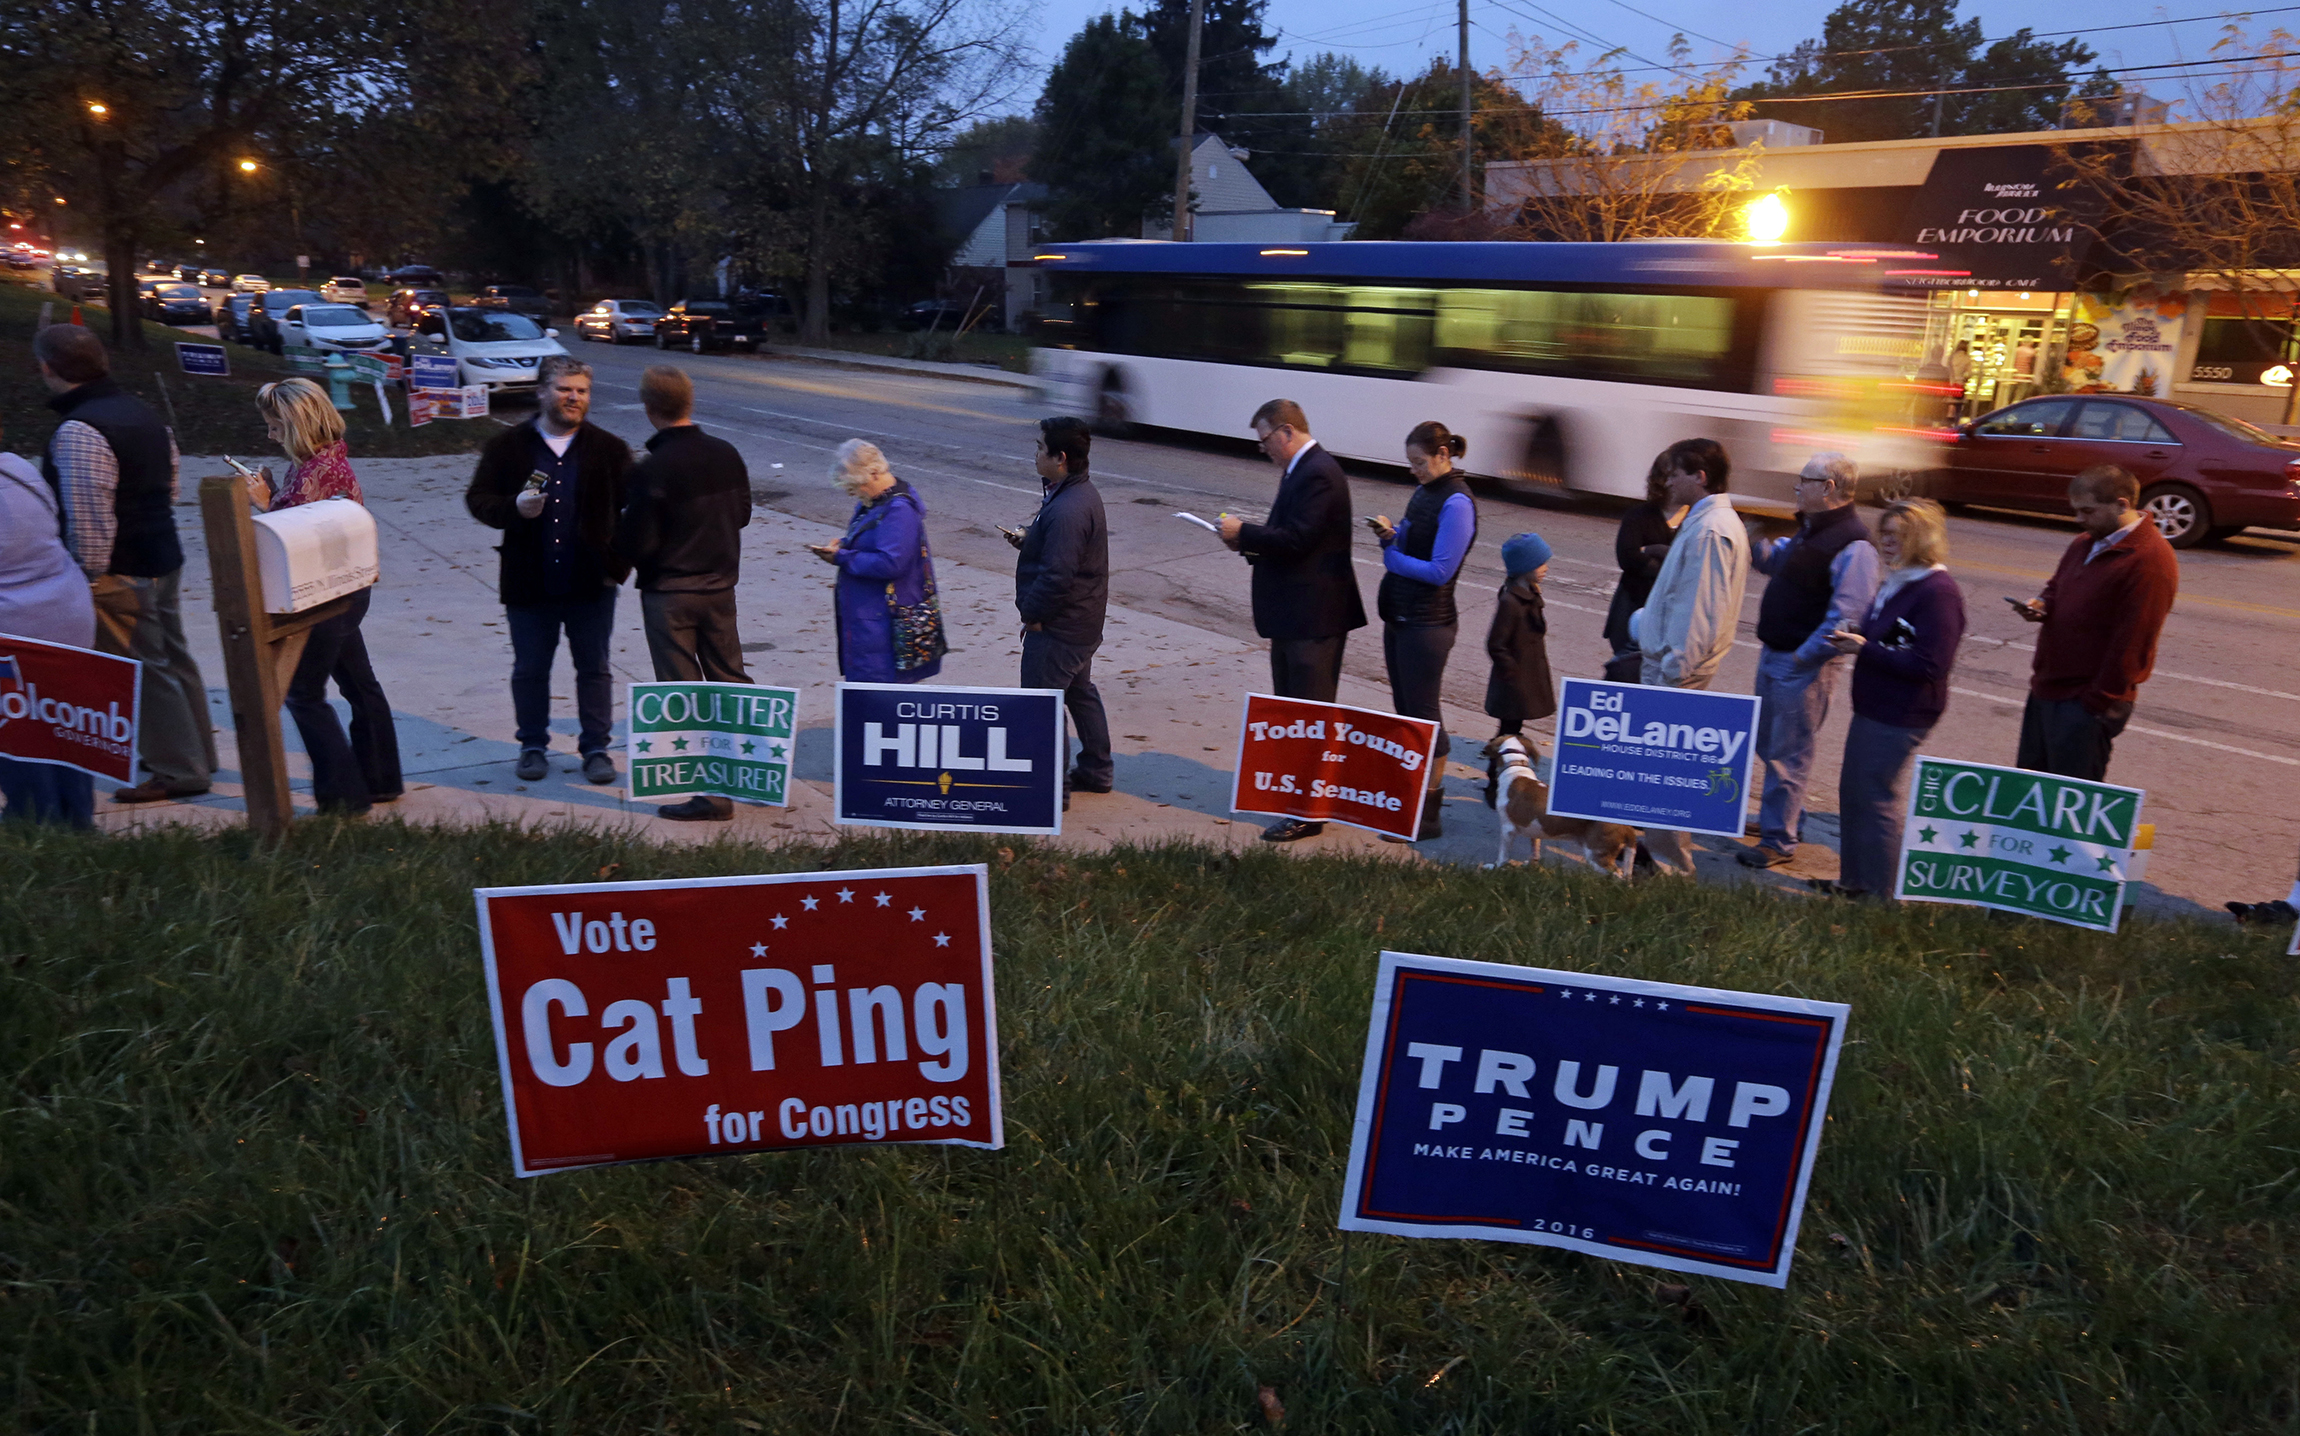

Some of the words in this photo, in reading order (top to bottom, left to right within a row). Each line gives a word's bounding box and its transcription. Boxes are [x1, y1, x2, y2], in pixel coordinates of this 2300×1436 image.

[1916, 226, 2074, 244] EMPORIUM
[1957, 207, 2047, 225] FOOD
[2191, 366, 2233, 379] 5550
[0, 682, 132, 743] olcomb
[635, 691, 790, 730] COULTER
[896, 701, 1000, 722] CURTIS
[1588, 690, 1624, 712] Ed
[53, 726, 132, 758] GOVERNOR
[700, 736, 732, 750] FOR
[863, 721, 1033, 773] HILL
[1249, 719, 1325, 742] Todd
[1333, 721, 1424, 771] Young
[1563, 706, 1748, 765] DeLaney
[1601, 743, 1643, 756] HOUSE
[1644, 748, 1699, 762] DISTRICT
[1321, 750, 1347, 763] for
[1560, 763, 1614, 779] LEADING
[1616, 769, 1635, 782] ON
[1637, 772, 1662, 785] THE
[634, 761, 782, 794] TREASURER
[1254, 771, 1303, 795] U.S.
[1310, 779, 1402, 812] Senate
[1920, 767, 1944, 812] CHIC
[883, 797, 949, 811] ATTORNEY
[949, 799, 1008, 813] GENERAL
[1943, 770, 2125, 842] CLARK
[1988, 833, 2034, 856] FOR
[1907, 860, 2106, 918] SURVEYOR
[551, 911, 657, 956] Vote
[521, 976, 710, 1088] Cat
[740, 963, 969, 1083] Ping
[1406, 1041, 1791, 1129] TRUMP
[704, 1103, 764, 1145] for
[779, 1095, 972, 1141] Congress
[1428, 1102, 1741, 1169] PENCE
[1413, 1142, 1473, 1160] MAKE
[1479, 1147, 1578, 1174] AMERICA
[1584, 1163, 1659, 1187] GREAT
[1663, 1176, 1742, 1197] AGAIN!
[1533, 1217, 1595, 1241] 2016
